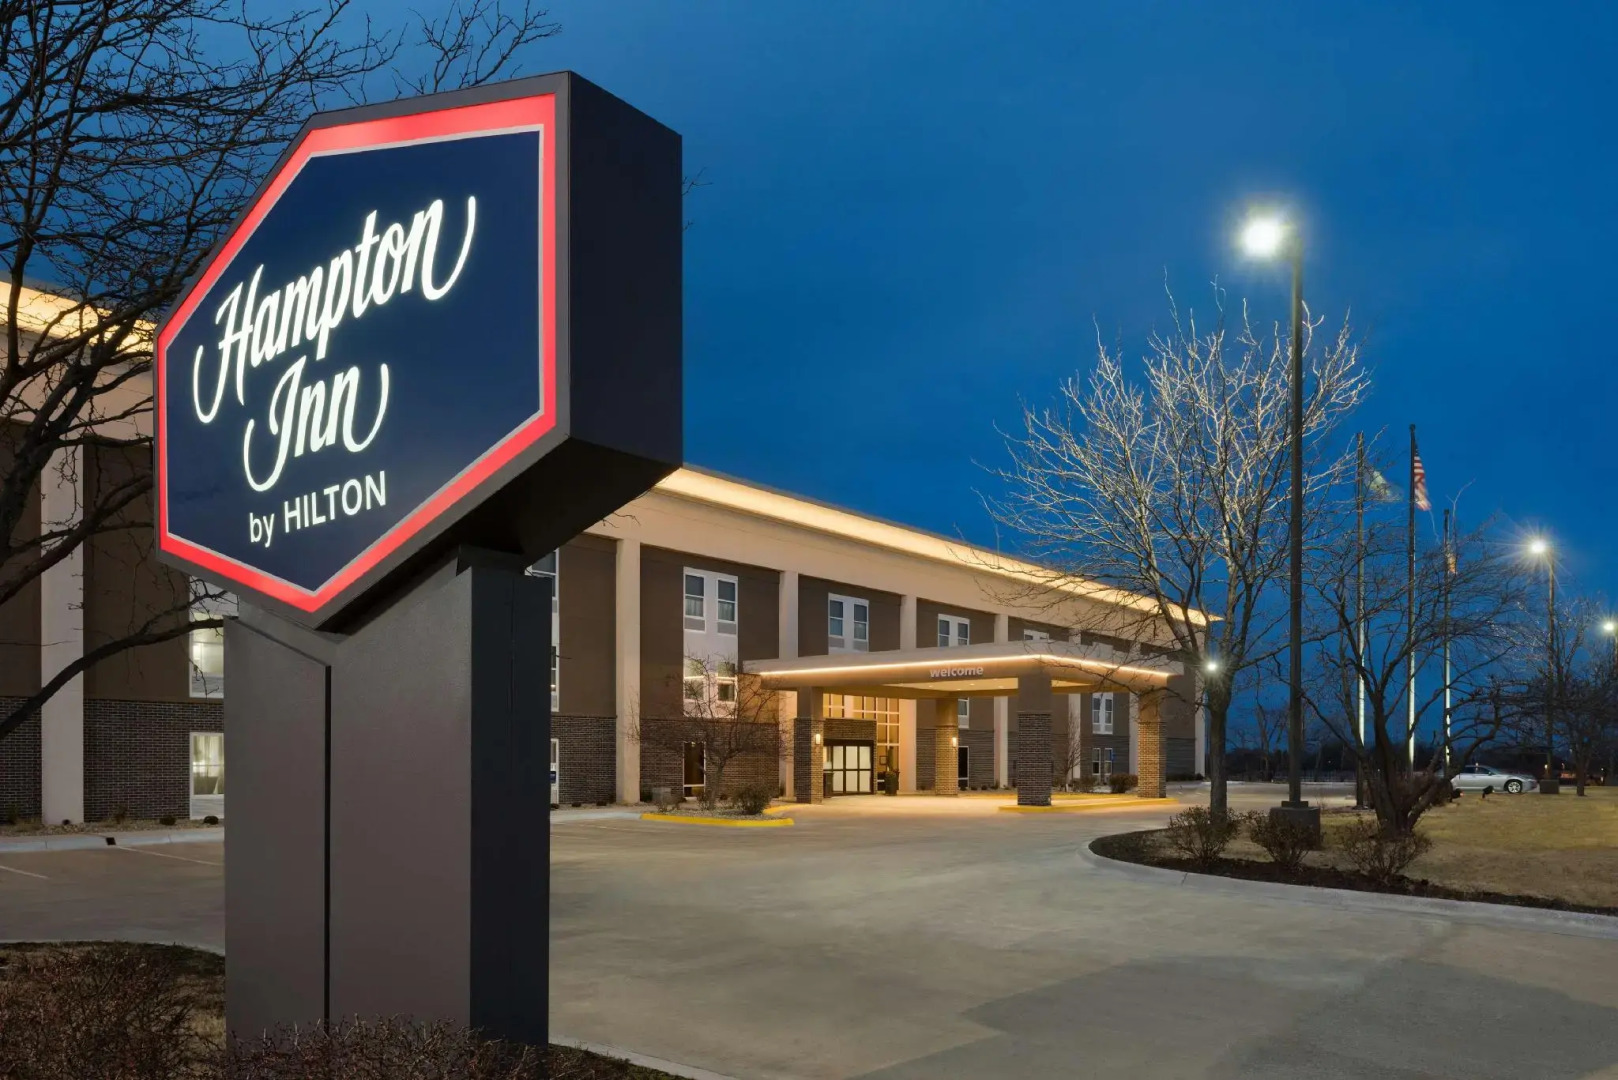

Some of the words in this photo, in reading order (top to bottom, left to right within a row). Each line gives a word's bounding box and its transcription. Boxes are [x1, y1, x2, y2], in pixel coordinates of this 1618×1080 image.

[191, 194, 478, 424] Hampton
[242, 355, 391, 493] Inn
[249, 512, 275, 548] by
[284, 470, 387, 533] HILTON
[929, 666, 984, 678] welcome
